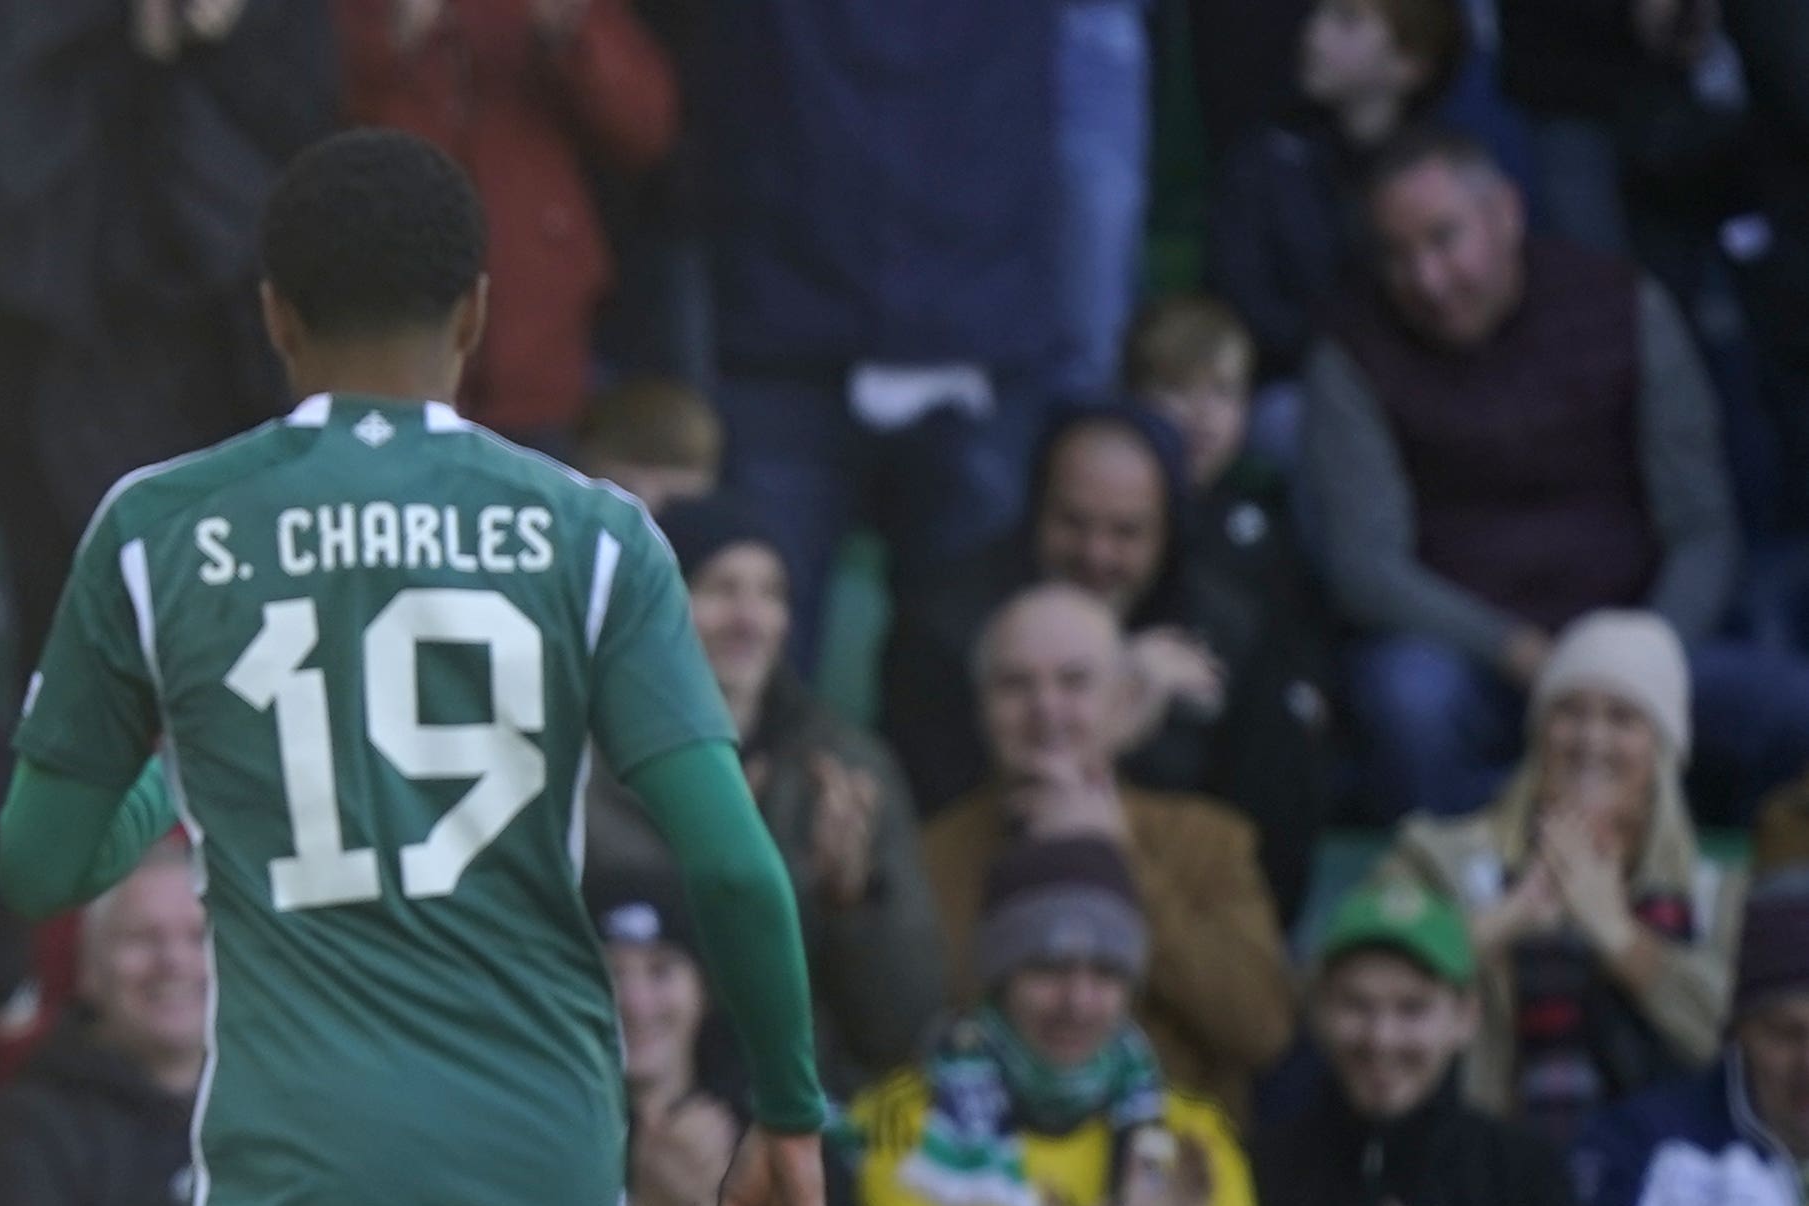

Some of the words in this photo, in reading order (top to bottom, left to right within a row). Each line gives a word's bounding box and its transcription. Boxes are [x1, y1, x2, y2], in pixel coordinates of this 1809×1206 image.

[194, 516, 254, 586] S.
[276, 501, 555, 577] CHARLES
[223, 587, 546, 912] 19
